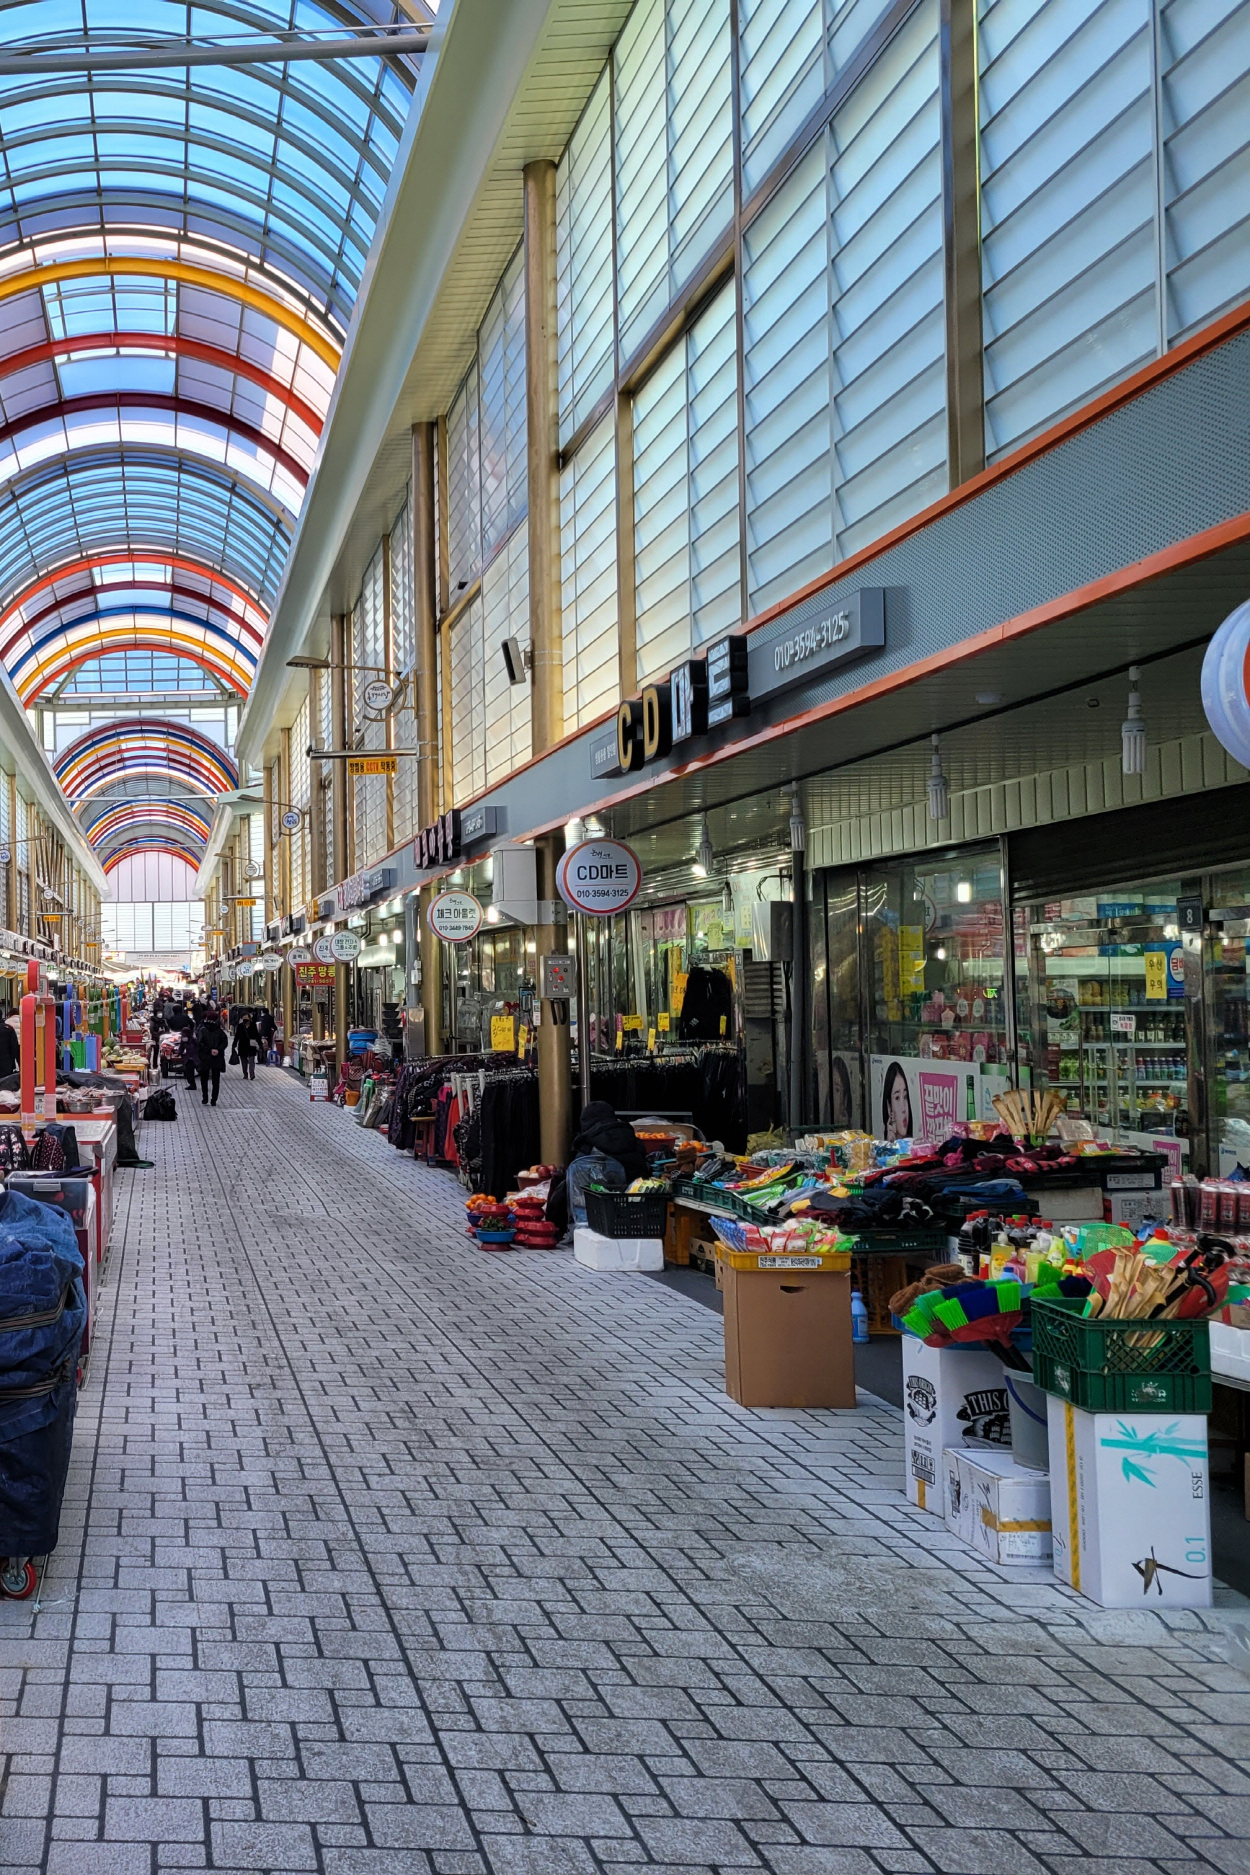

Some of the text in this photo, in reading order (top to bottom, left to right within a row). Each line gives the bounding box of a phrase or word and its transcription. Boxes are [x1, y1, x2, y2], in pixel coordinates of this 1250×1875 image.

[774, 613, 849, 672] 010-3594-3125
[366, 762, 379, 772] CCTV
[577, 864, 628, 880] CD마트
[437, 908, 476, 919] 체크 아울렛
[1186, 909, 1193, 924] 8
[299, 966, 316, 978] 진주
[968, 1392, 1001, 1414] THIS
[1193, 1471, 1203, 1499] ESSE
[1185, 1537, 1206, 1563] 0.1
